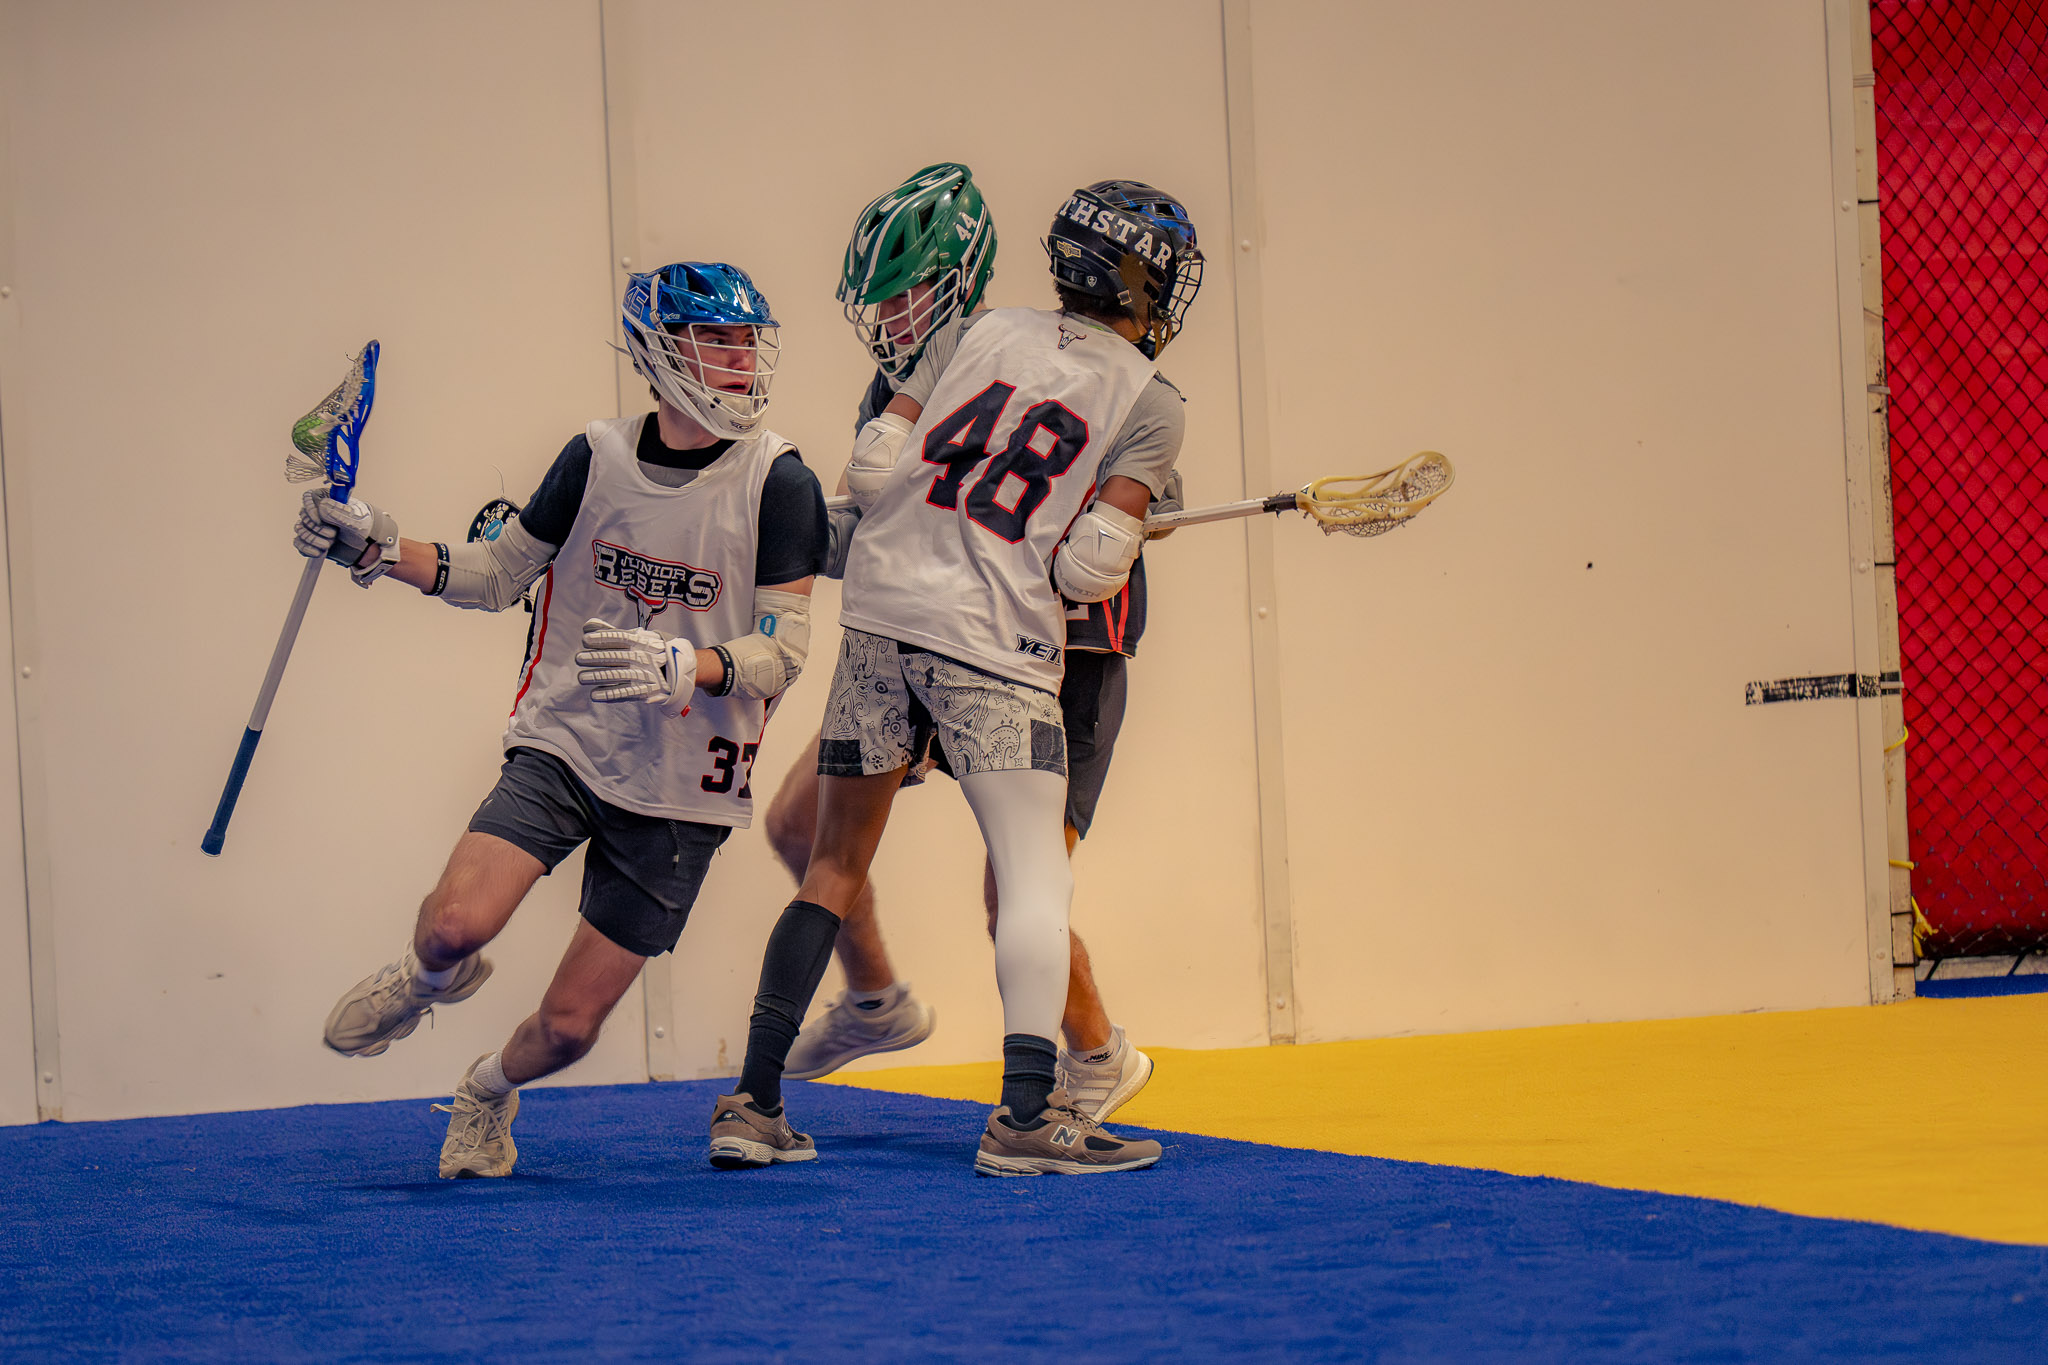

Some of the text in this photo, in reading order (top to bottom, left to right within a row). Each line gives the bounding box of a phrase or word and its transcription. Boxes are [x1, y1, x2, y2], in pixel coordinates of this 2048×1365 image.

[953, 211, 978, 241] 44
[922, 380, 1090, 545] 48
[594, 543, 717, 606] REBELS
[620, 555, 686, 582] JUNIOR
[1050, 1124, 1081, 1147] N
